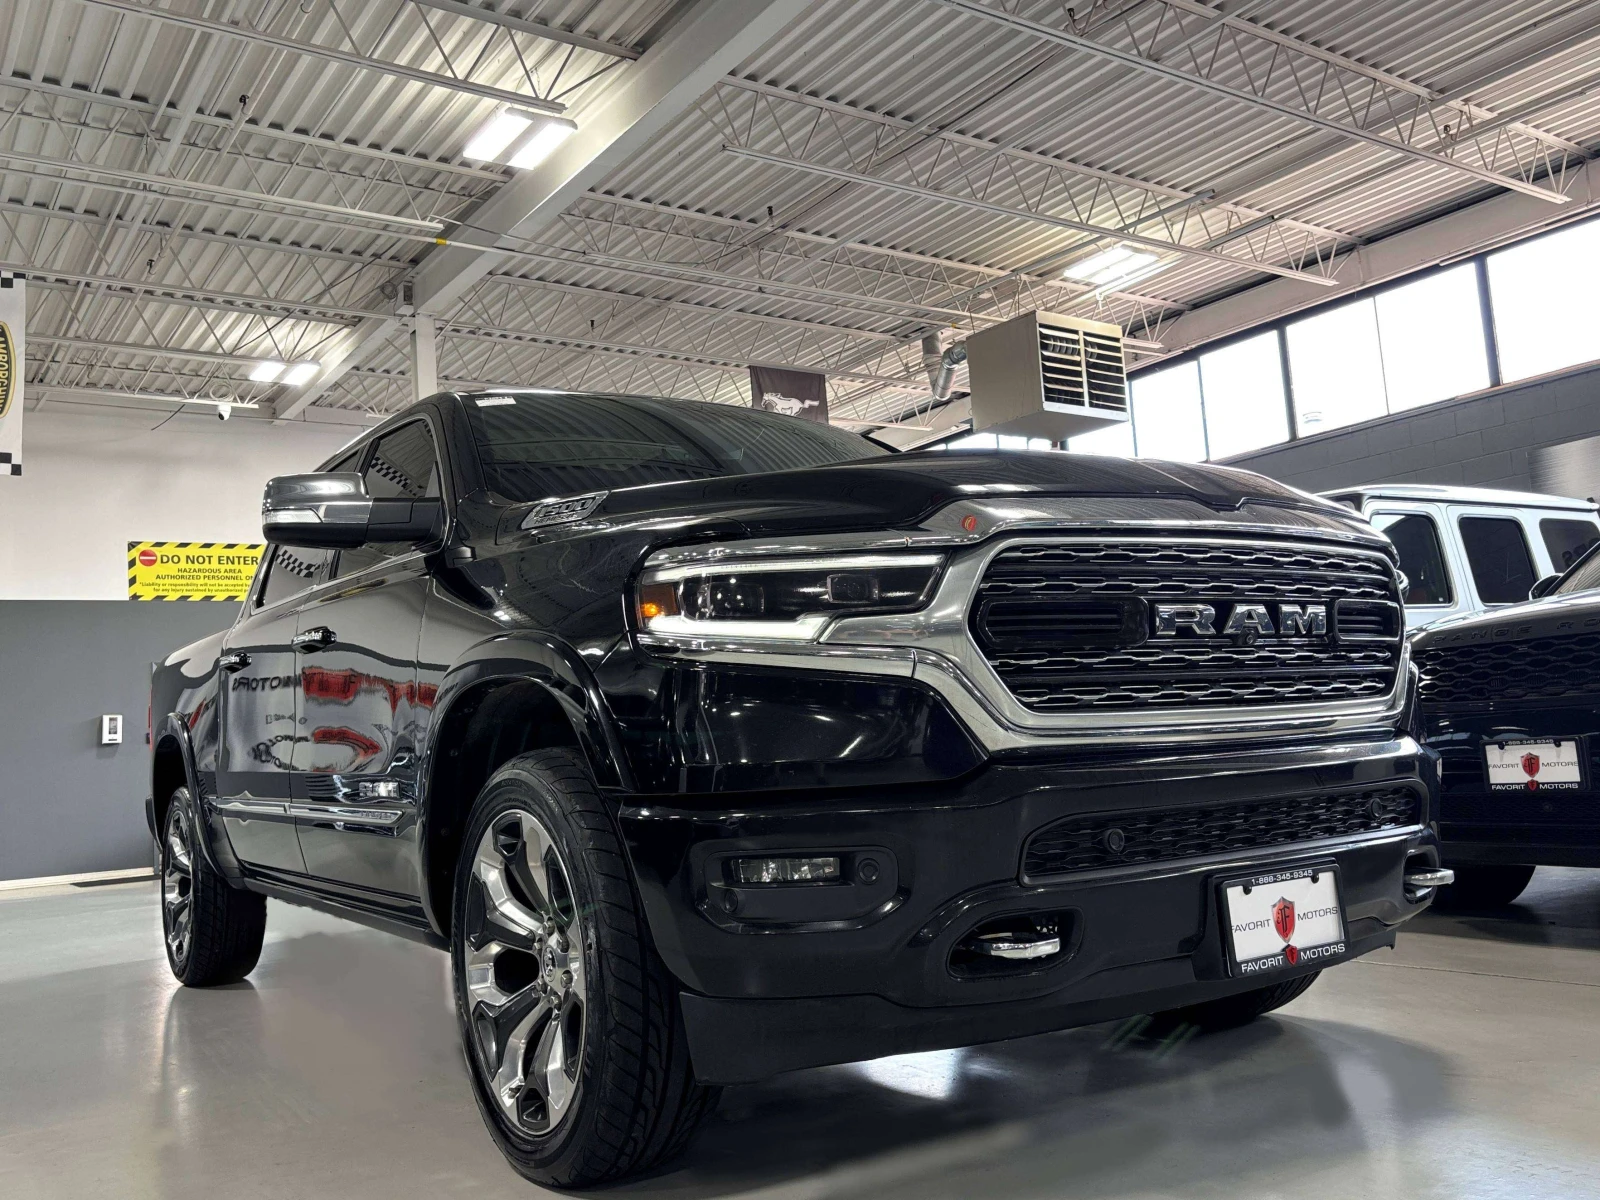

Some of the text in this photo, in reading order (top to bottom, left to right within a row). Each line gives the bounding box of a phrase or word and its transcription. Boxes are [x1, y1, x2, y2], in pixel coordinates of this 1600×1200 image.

[160, 554, 259, 566] DO NOT ENTER
[1154, 603, 1327, 635] RAM
[1251, 869, 1313, 886] 1-888-345-9345
[1231, 918, 1271, 934] FAVORIT
[1297, 906, 1339, 922] MOTORS
[1241, 943, 1346, 974] FAVORIT MOTORS
